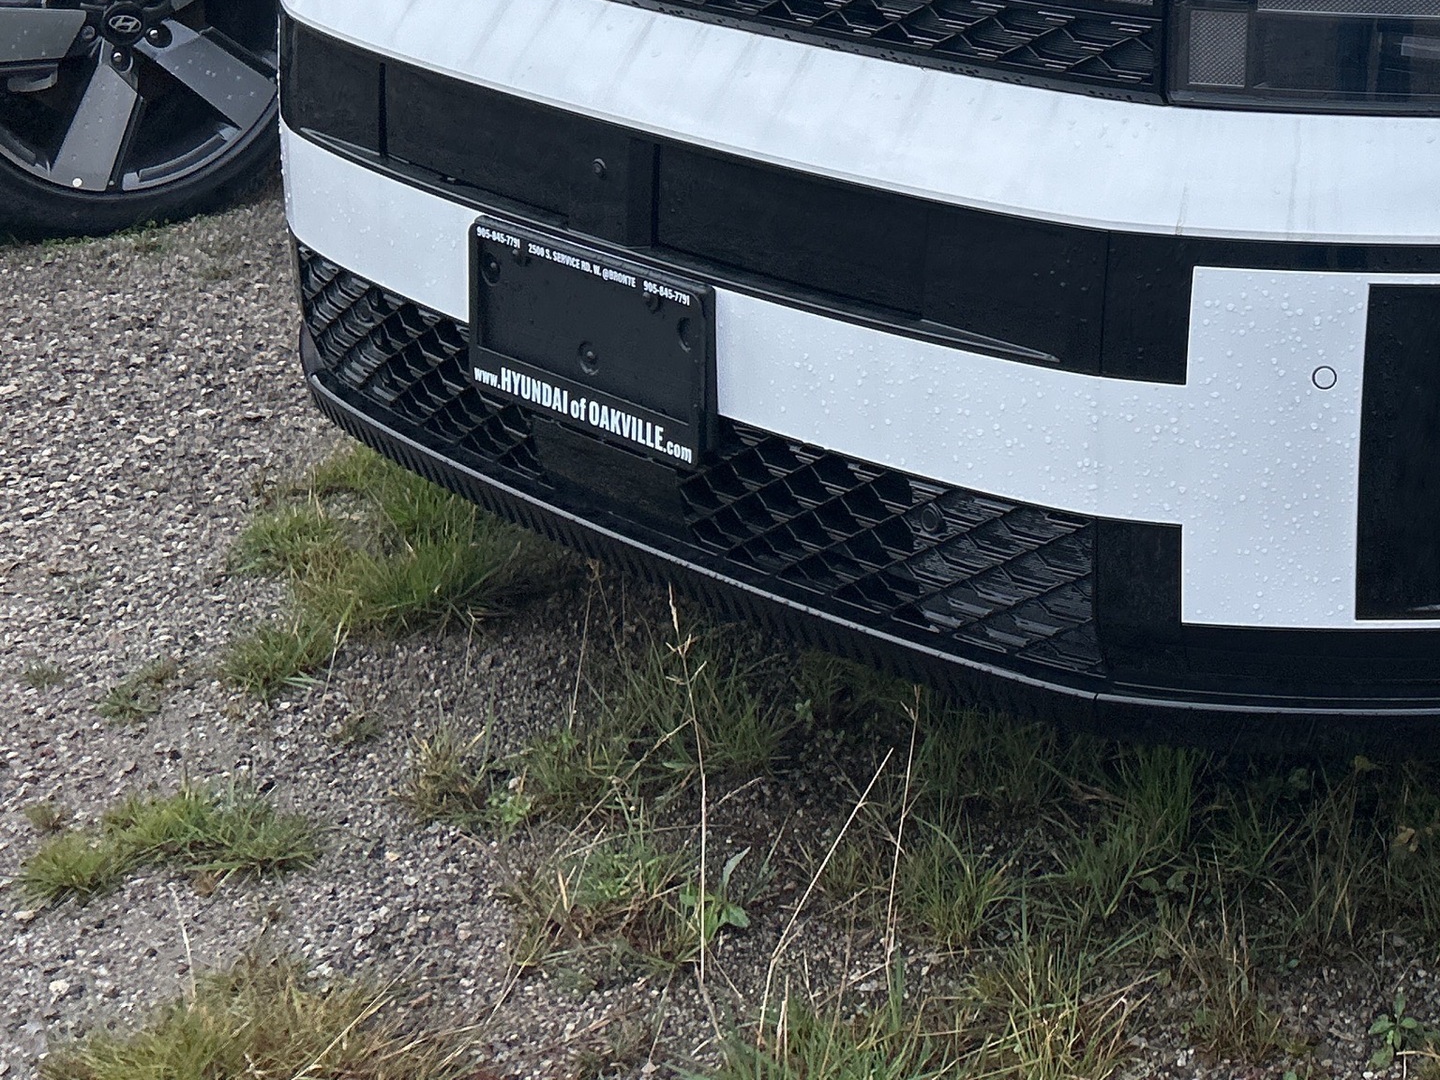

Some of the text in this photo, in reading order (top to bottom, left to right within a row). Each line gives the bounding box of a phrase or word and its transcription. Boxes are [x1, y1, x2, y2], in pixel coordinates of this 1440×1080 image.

[476, 226, 521, 249] 905-845-7791
[527, 243, 545, 258] 2500
[545, 248, 552, 260] S.
[552, 251, 581, 270] SERVICE
[580, 260, 593, 274] RD.
[643, 280, 690, 306] 905-845-7791
[473, 367, 693, 464] www.HYUNDAI of OAKVILLE.com
